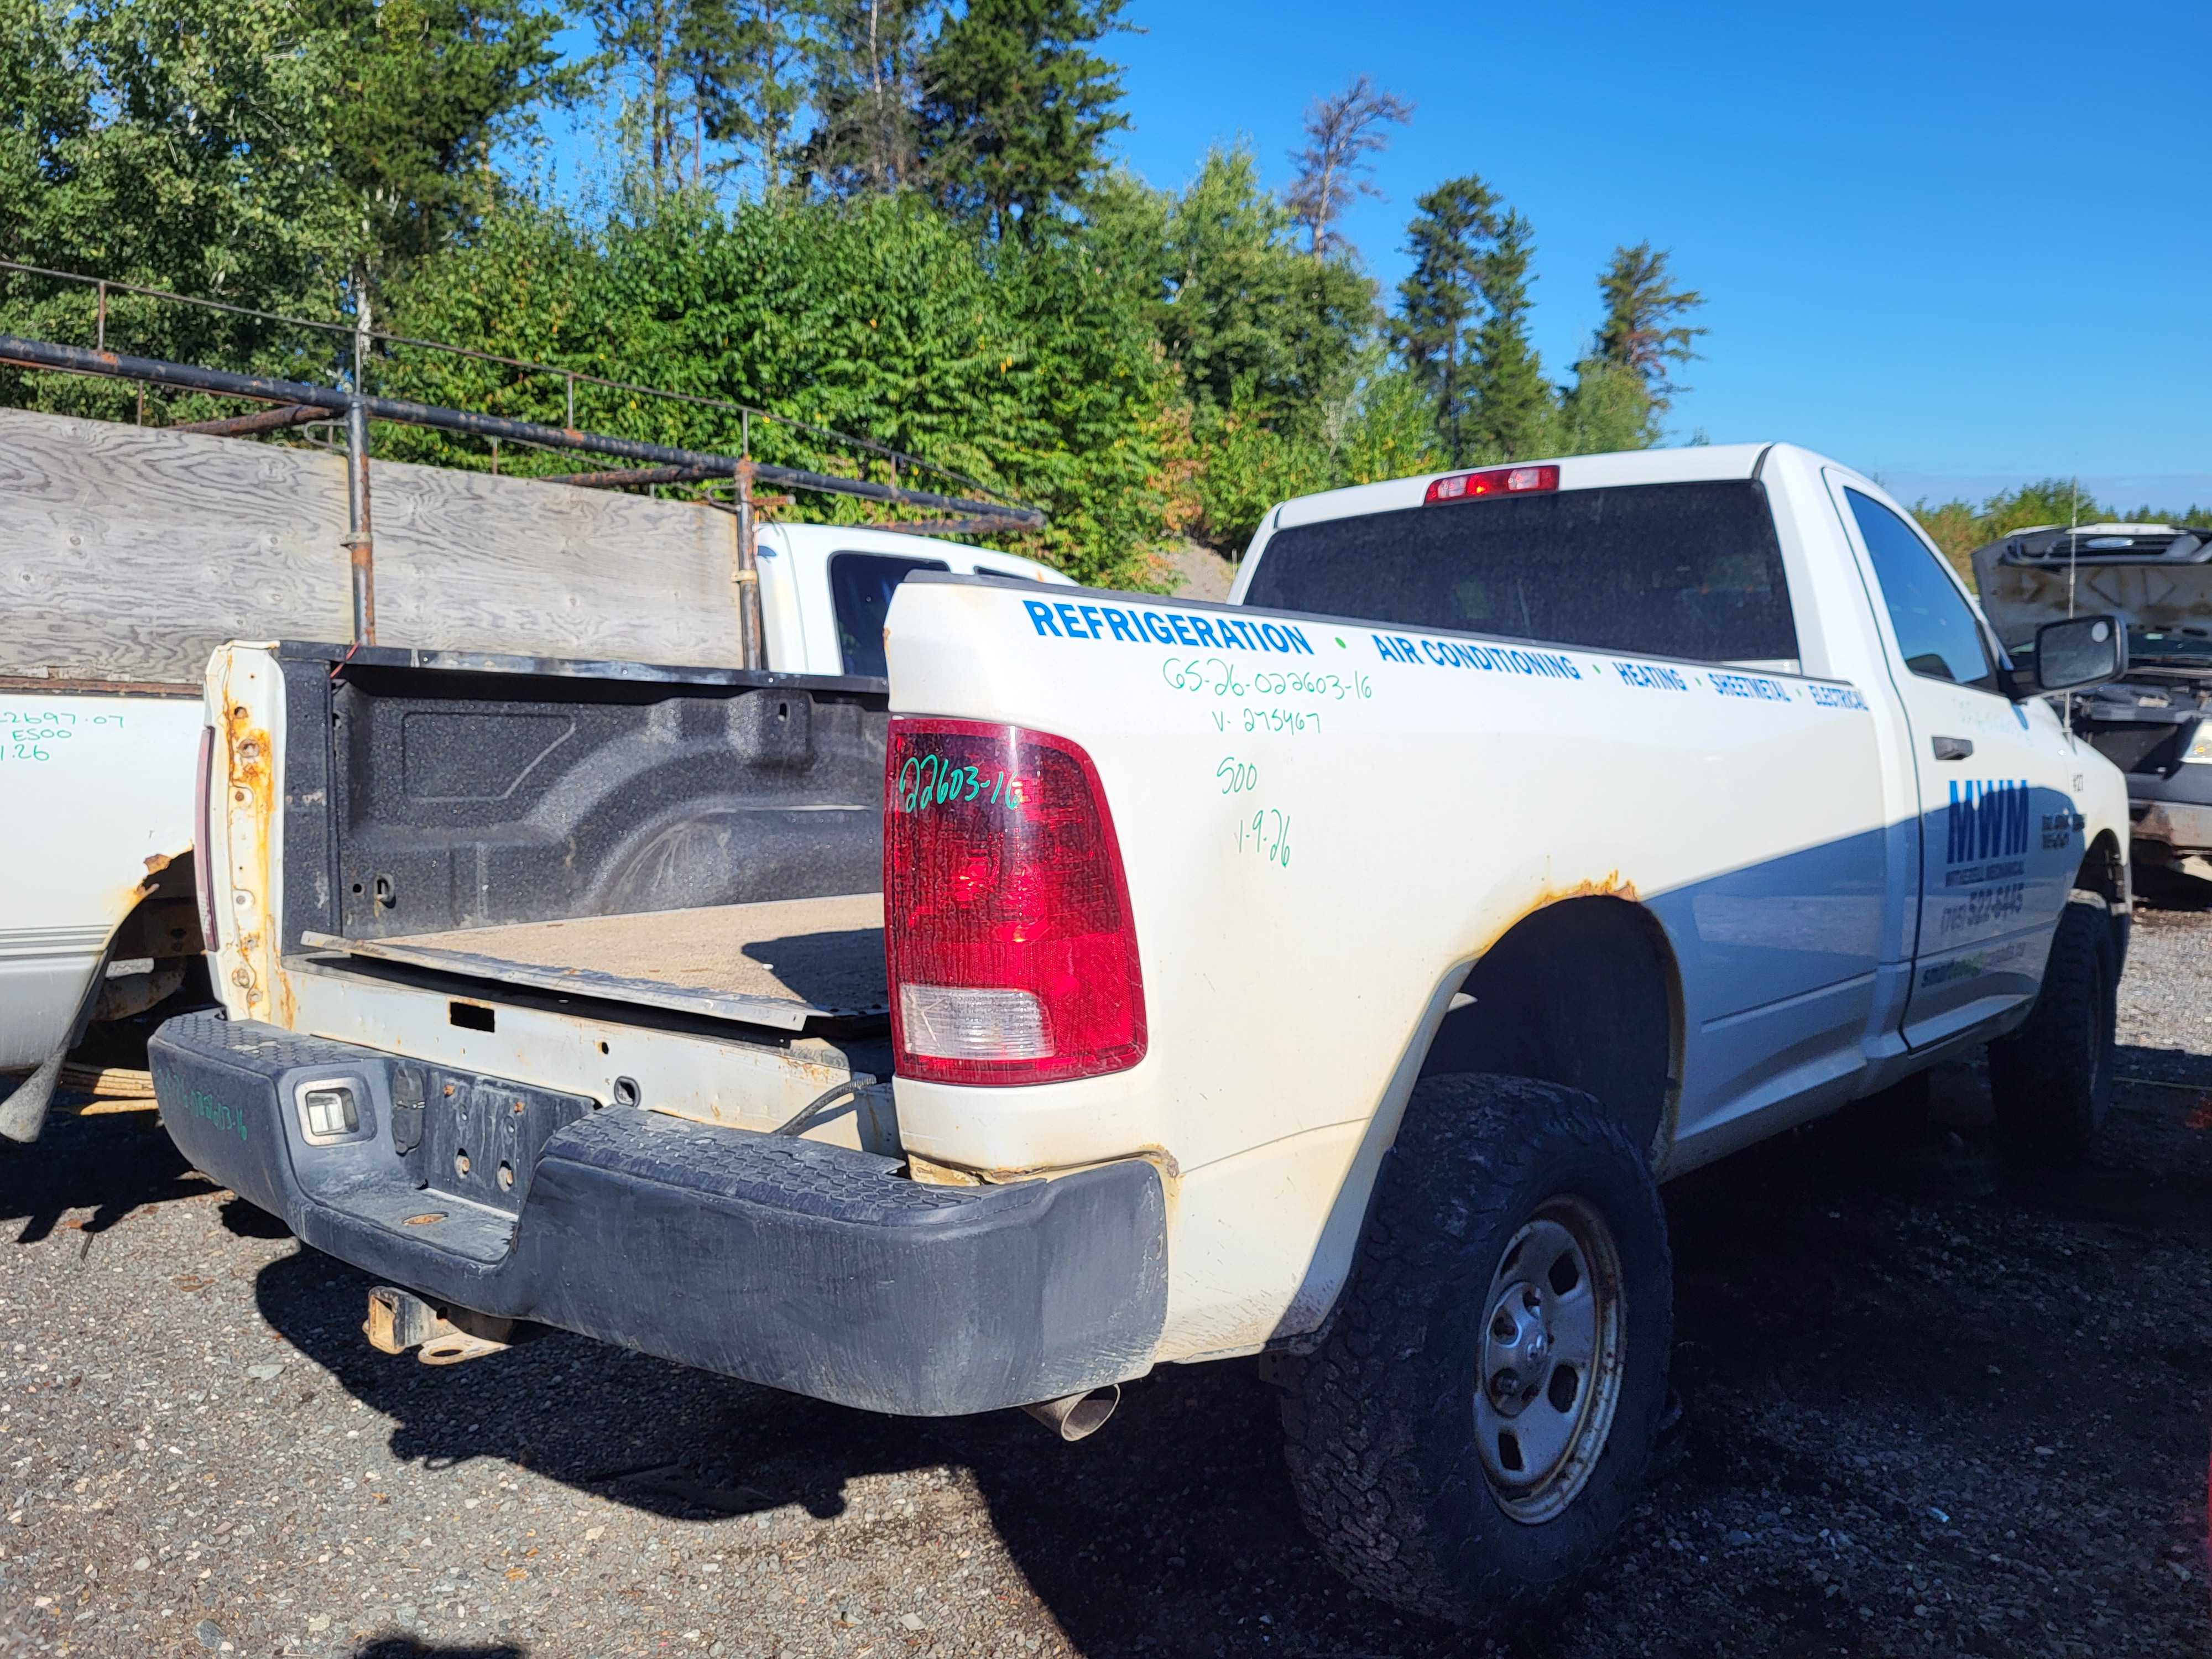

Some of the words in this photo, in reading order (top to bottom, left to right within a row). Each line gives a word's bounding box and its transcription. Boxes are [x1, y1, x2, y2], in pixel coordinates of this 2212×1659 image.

[1022, 600, 1314, 655] REFRIGERATION
[1371, 635, 1425, 664] AIR
[1421, 640, 1582, 680] CONDITIONING
[1612, 662, 1688, 691] HEATING
